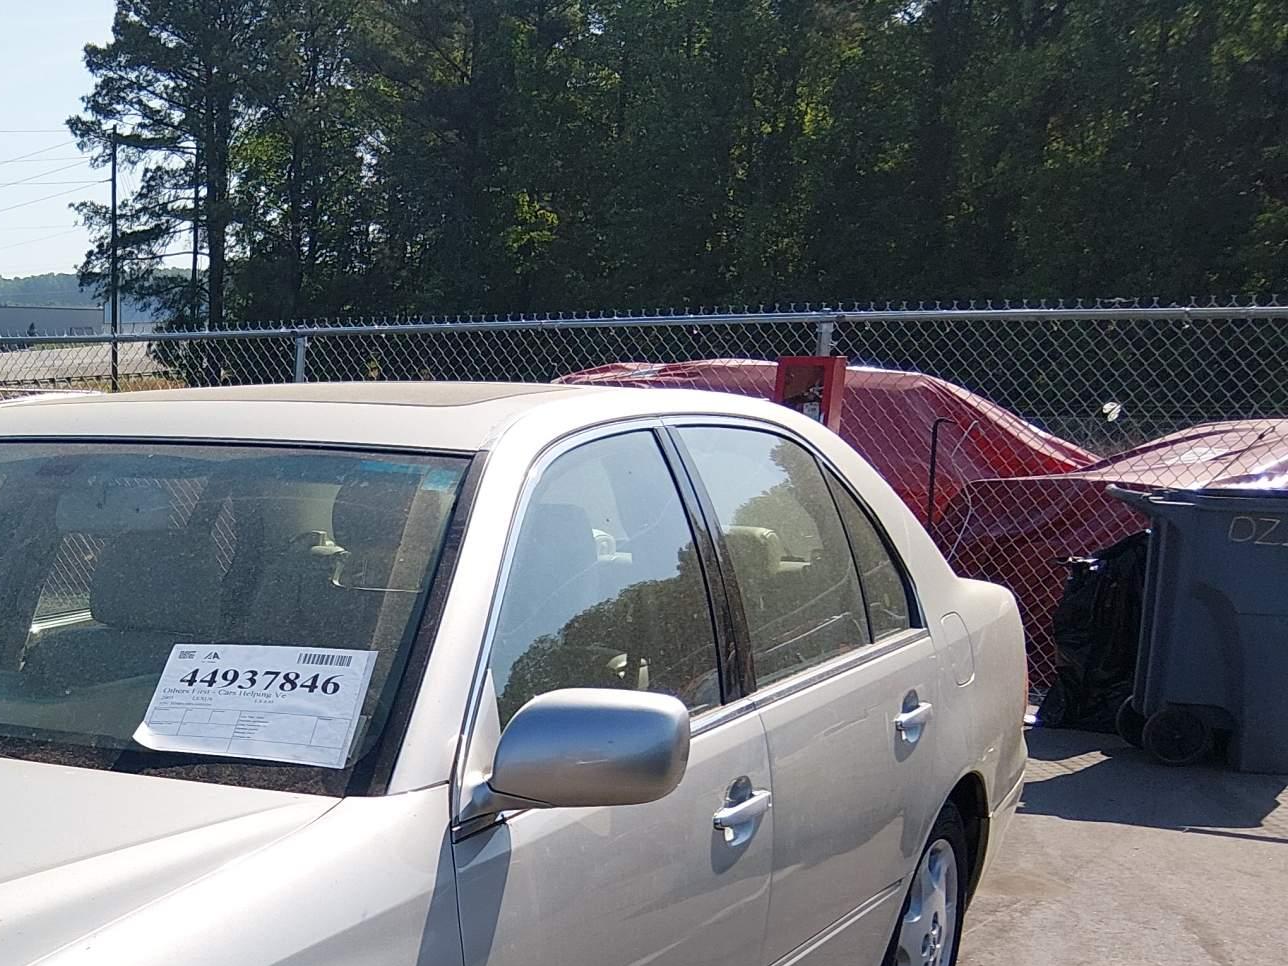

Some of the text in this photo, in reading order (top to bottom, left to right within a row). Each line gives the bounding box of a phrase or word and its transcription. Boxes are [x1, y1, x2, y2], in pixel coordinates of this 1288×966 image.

[179, 667, 345, 696] 44937846
[218, 688, 237, 696] Cars
[239, 690, 272, 699] Helping
